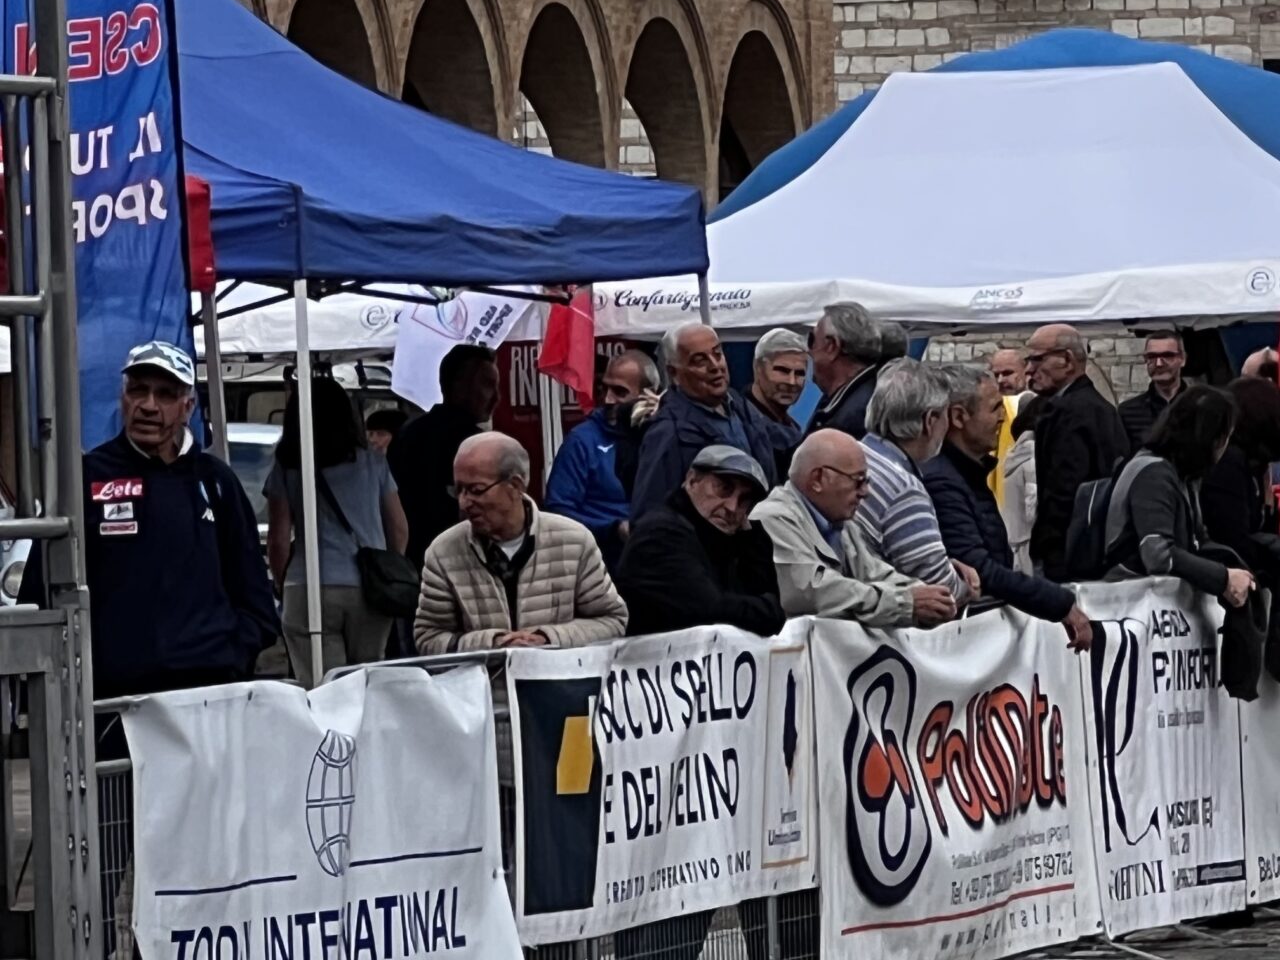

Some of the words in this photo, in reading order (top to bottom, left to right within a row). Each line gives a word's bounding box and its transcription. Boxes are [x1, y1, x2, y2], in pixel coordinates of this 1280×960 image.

[615, 289, 751, 312] Confartiginato
[93, 480, 142, 500] Lete
[637, 665, 674, 736] DI
